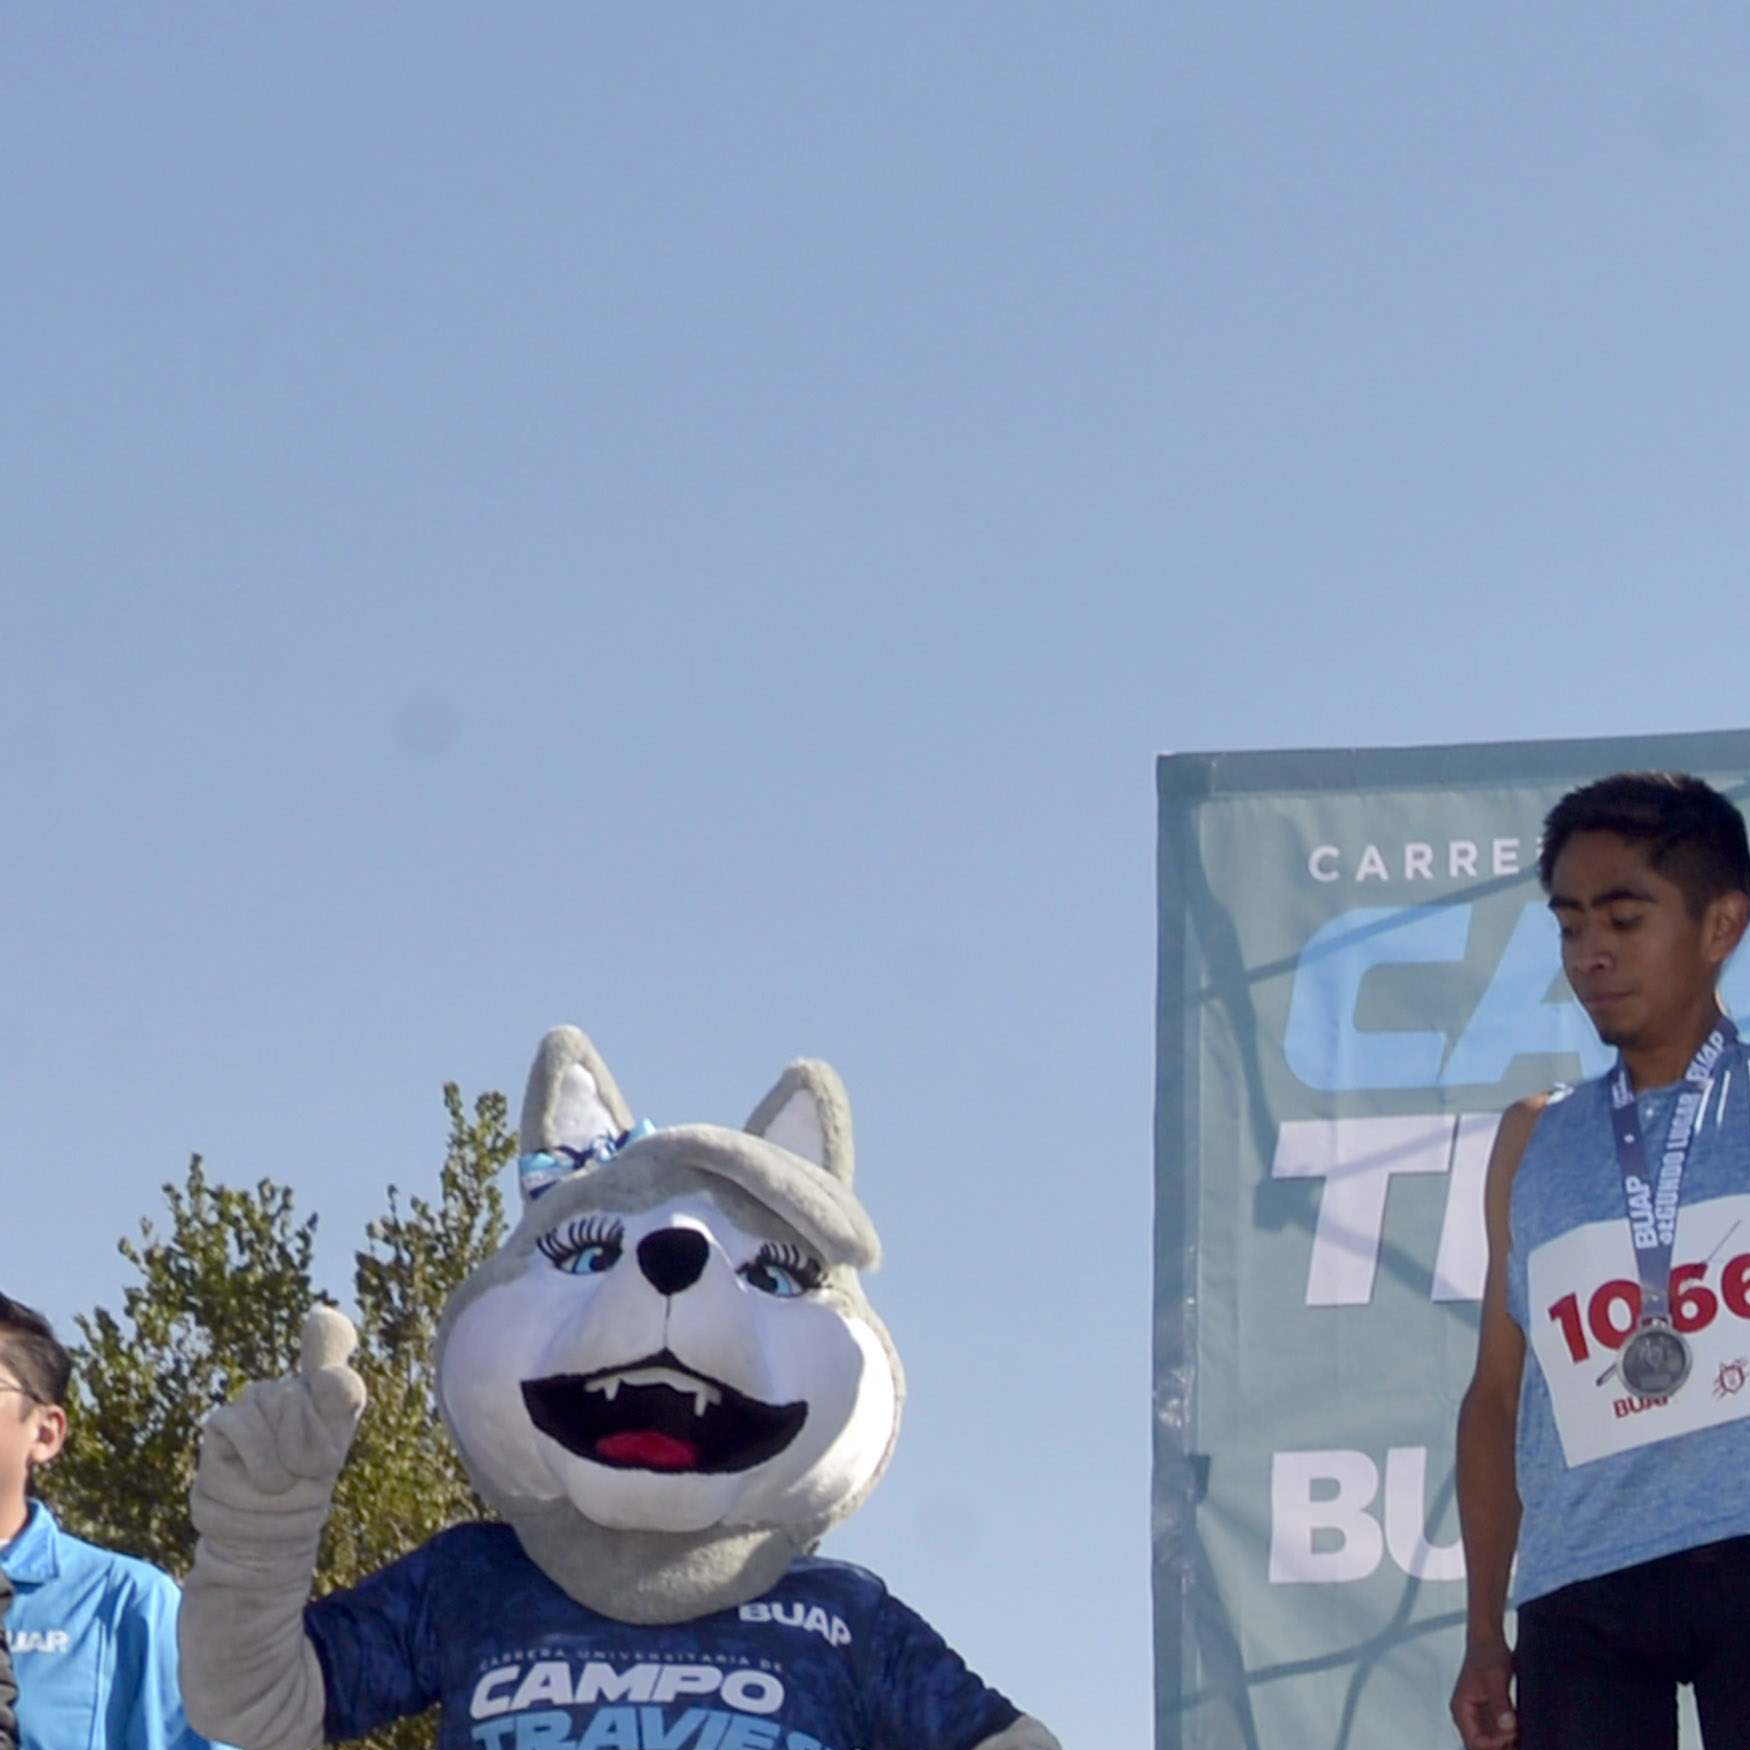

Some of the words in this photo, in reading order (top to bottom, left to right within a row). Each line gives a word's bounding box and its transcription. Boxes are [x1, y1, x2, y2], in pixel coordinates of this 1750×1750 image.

[1308, 837, 1545, 882] CARRE
[1624, 1174, 1660, 1250] BUAP
[1268, 1446, 1518, 1585] BU
[5, 1628, 69, 1654] UAP
[738, 1602, 852, 1647] BUAP
[470, 1661, 785, 1720] CAMPO
